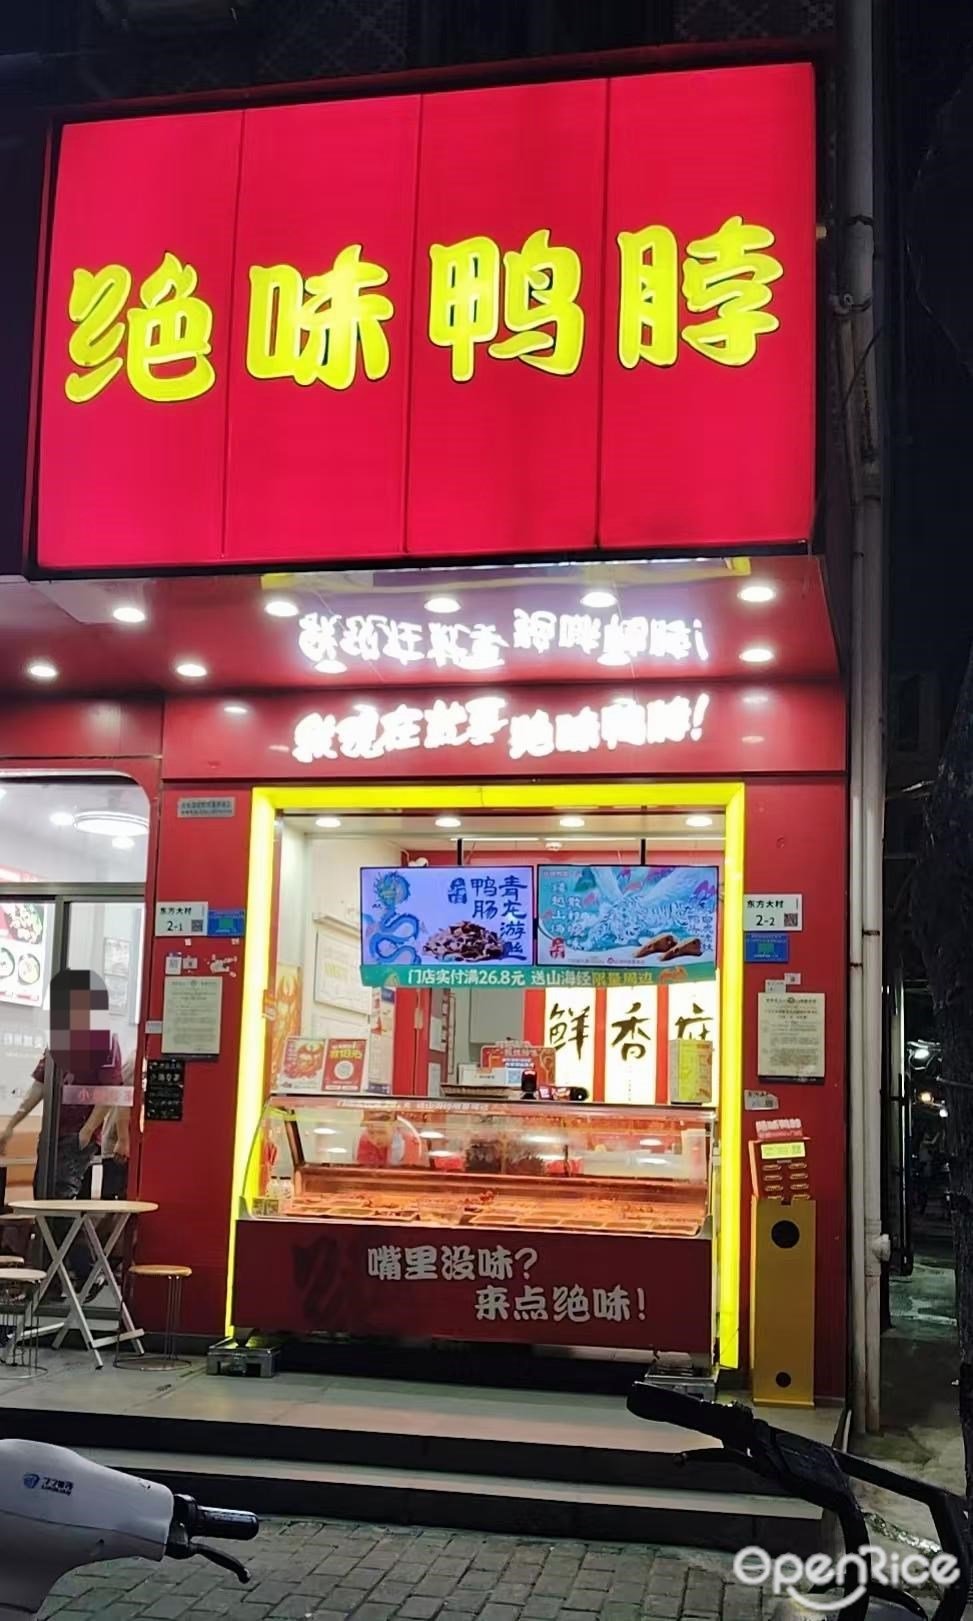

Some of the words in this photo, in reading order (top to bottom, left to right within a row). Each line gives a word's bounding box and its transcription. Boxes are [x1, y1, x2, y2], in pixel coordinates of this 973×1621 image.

[64, 215, 784, 403] 绝味鸭脖
[470, 875, 498, 920] 鸭肠
[746, 899, 784, 909] 东方大村
[167, 920, 183, 931] 2-1
[755, 914, 775, 926] 2-2
[408, 968, 525, 985] 门店实付满26.8元
[547, 1003, 590, 1061] 鲜
[611, 1002, 651, 1061] 香
[368, 1245, 538, 1281] 嘴里没味?
[474, 1284, 646, 1322] 来点绝味!
